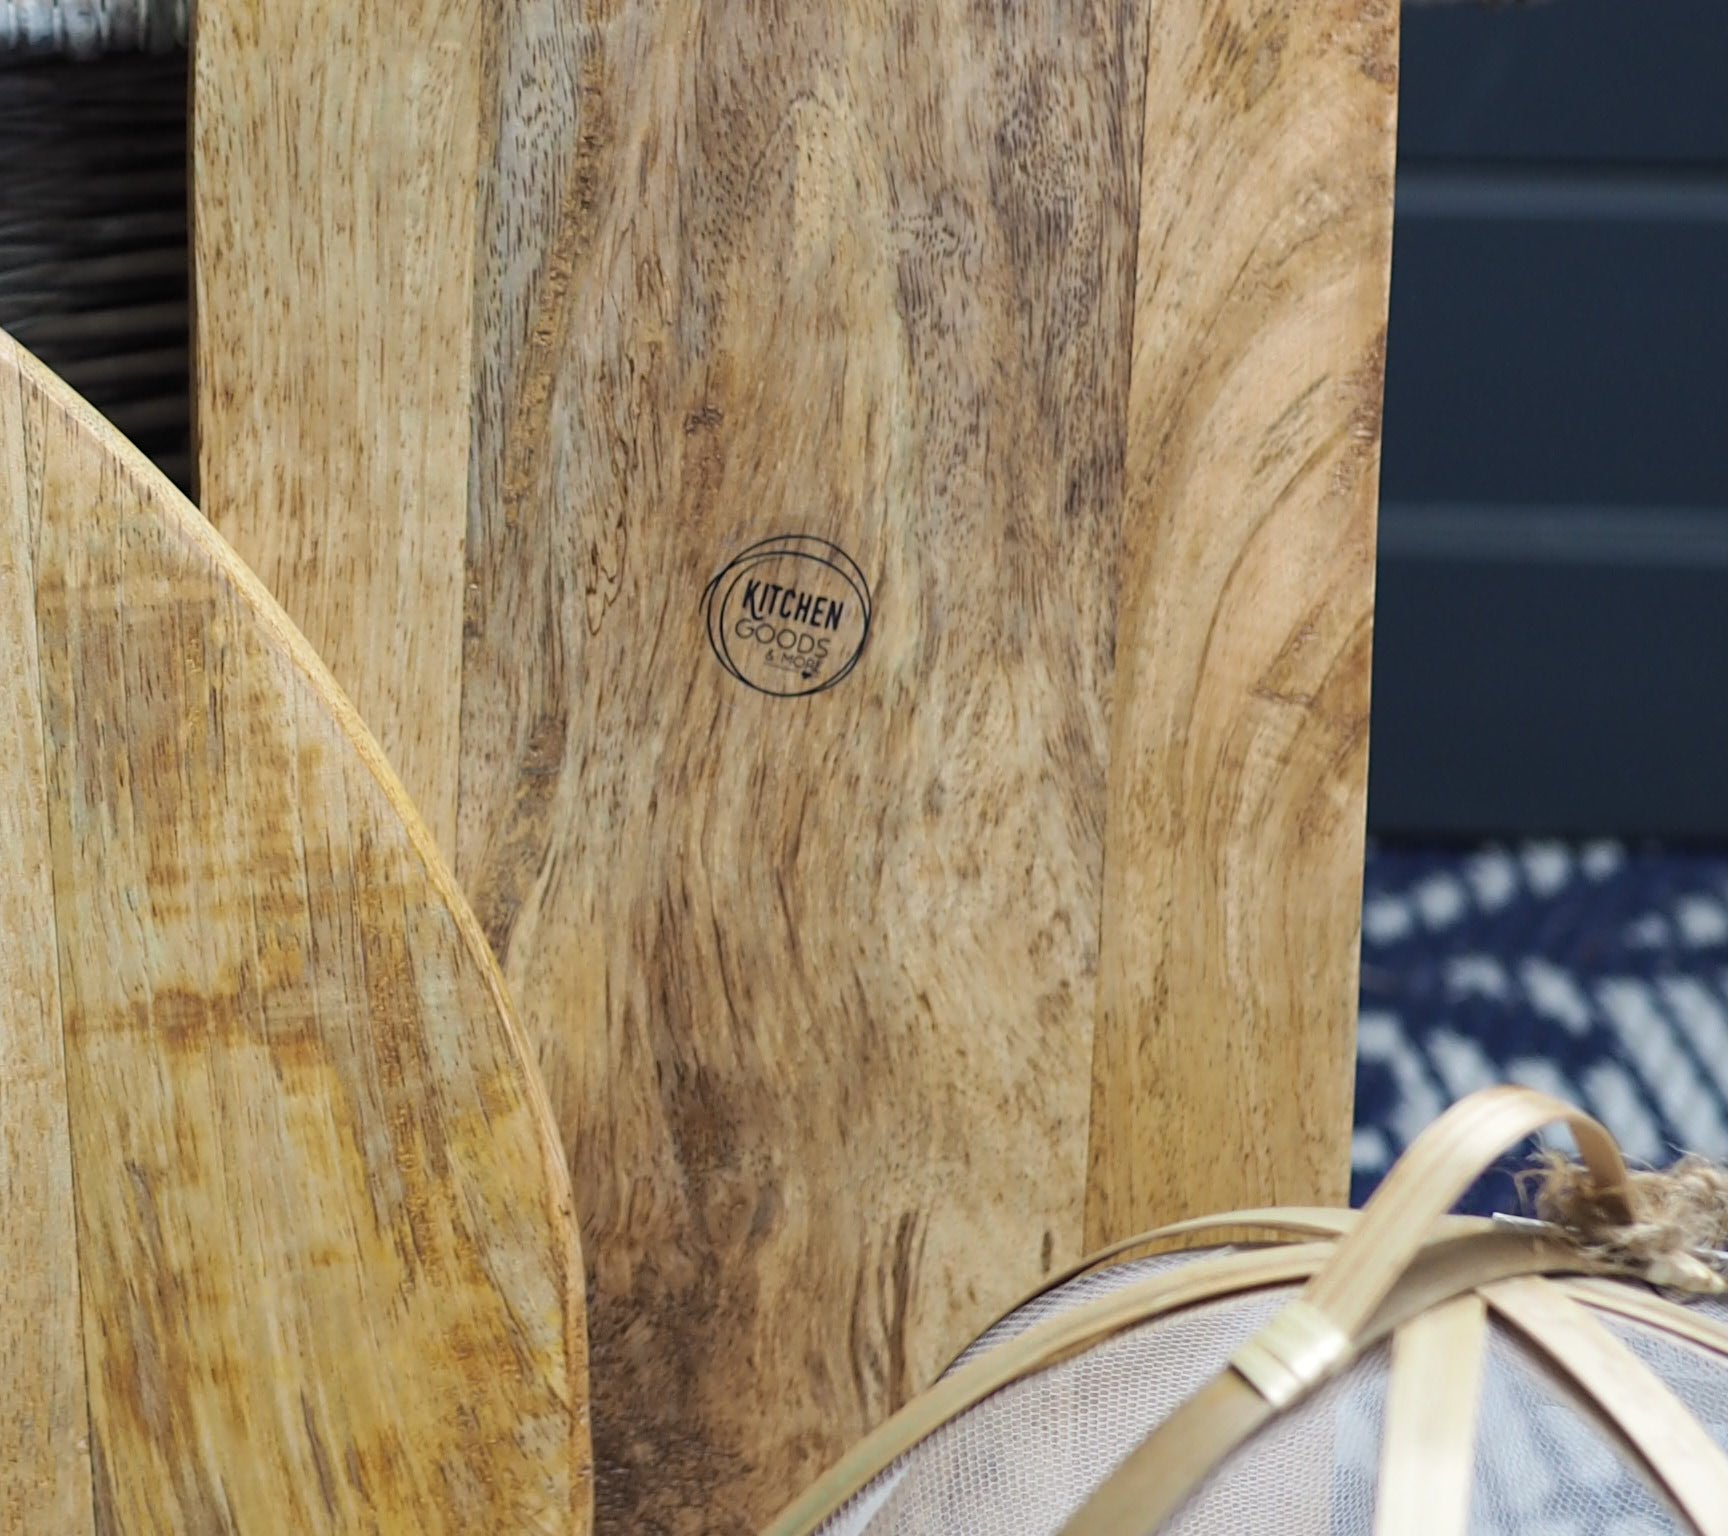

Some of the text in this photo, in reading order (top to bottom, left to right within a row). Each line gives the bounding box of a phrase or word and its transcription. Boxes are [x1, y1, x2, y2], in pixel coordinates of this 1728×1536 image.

[742, 579, 844, 631] KITCHEN
[735, 618, 831, 659] GOODS
[765, 649, 774, 662] &
